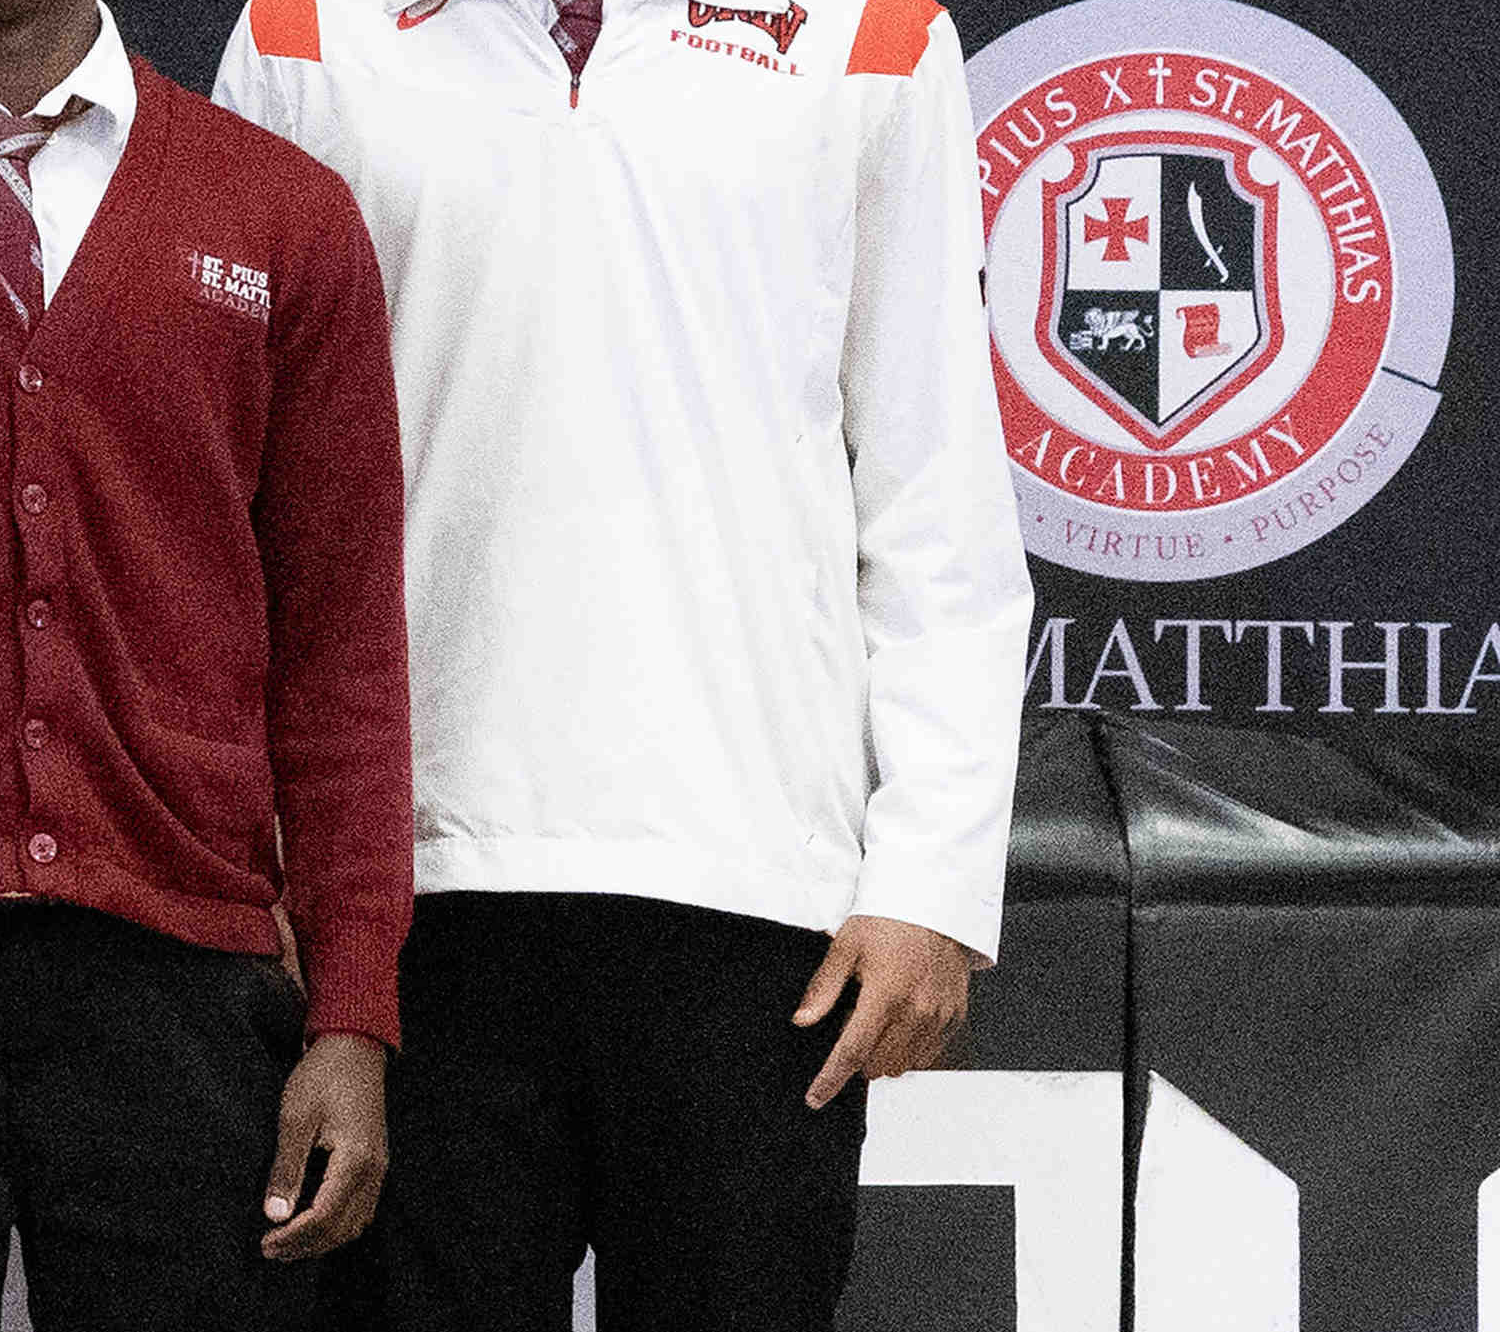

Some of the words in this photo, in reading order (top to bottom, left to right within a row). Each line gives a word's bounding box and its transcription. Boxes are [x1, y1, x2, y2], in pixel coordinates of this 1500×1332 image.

[669, 28, 805, 76] FOOTBALL
[1099, 66, 1133, 109] X
[1189, 68, 1251, 120] ST.
[1255, 98, 1383, 305] MATTHIAS
[231, 263, 269, 288] PIUS
[1015, 414, 1309, 505] ACADEMY
[1062, 518, 1205, 560] VIRTUE
[1250, 423, 1395, 542] PURPOSE
